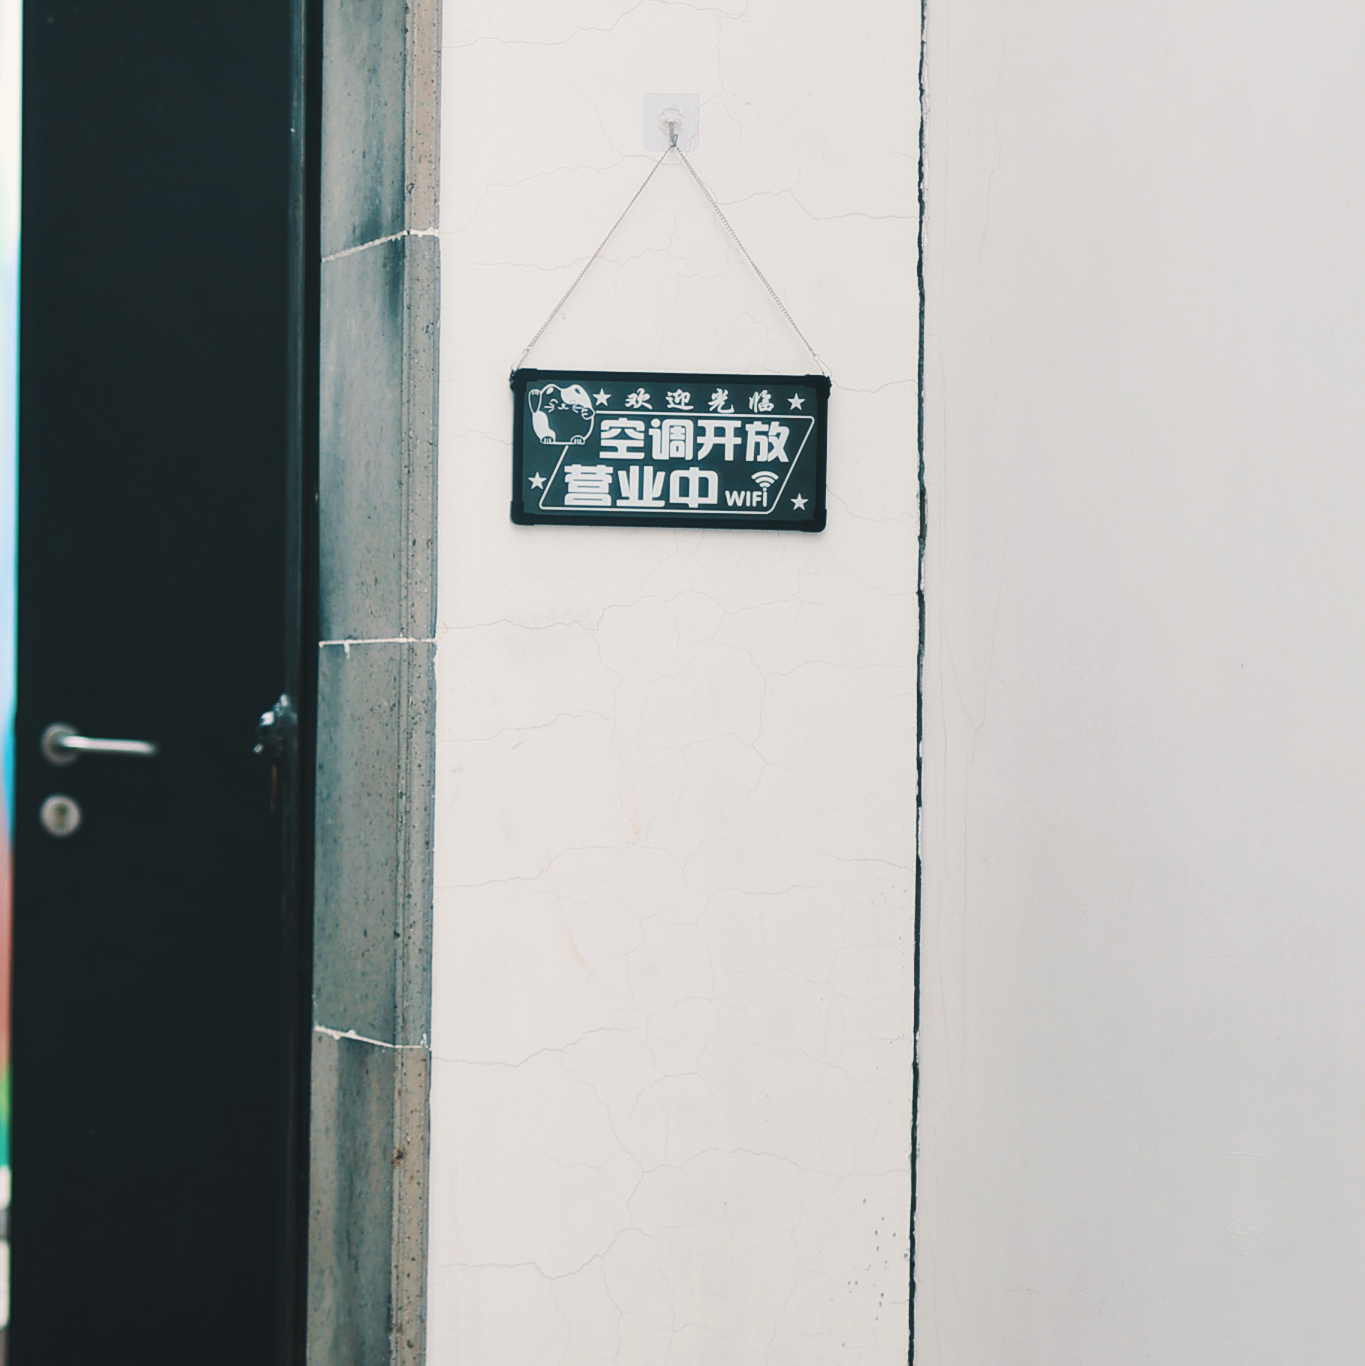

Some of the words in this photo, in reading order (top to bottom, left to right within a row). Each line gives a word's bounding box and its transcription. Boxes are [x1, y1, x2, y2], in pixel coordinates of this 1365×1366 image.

[624, 387, 775, 413] 欢迎光临
[599, 417, 790, 463] 空调开放
[563, 463, 719, 509] 营业中
